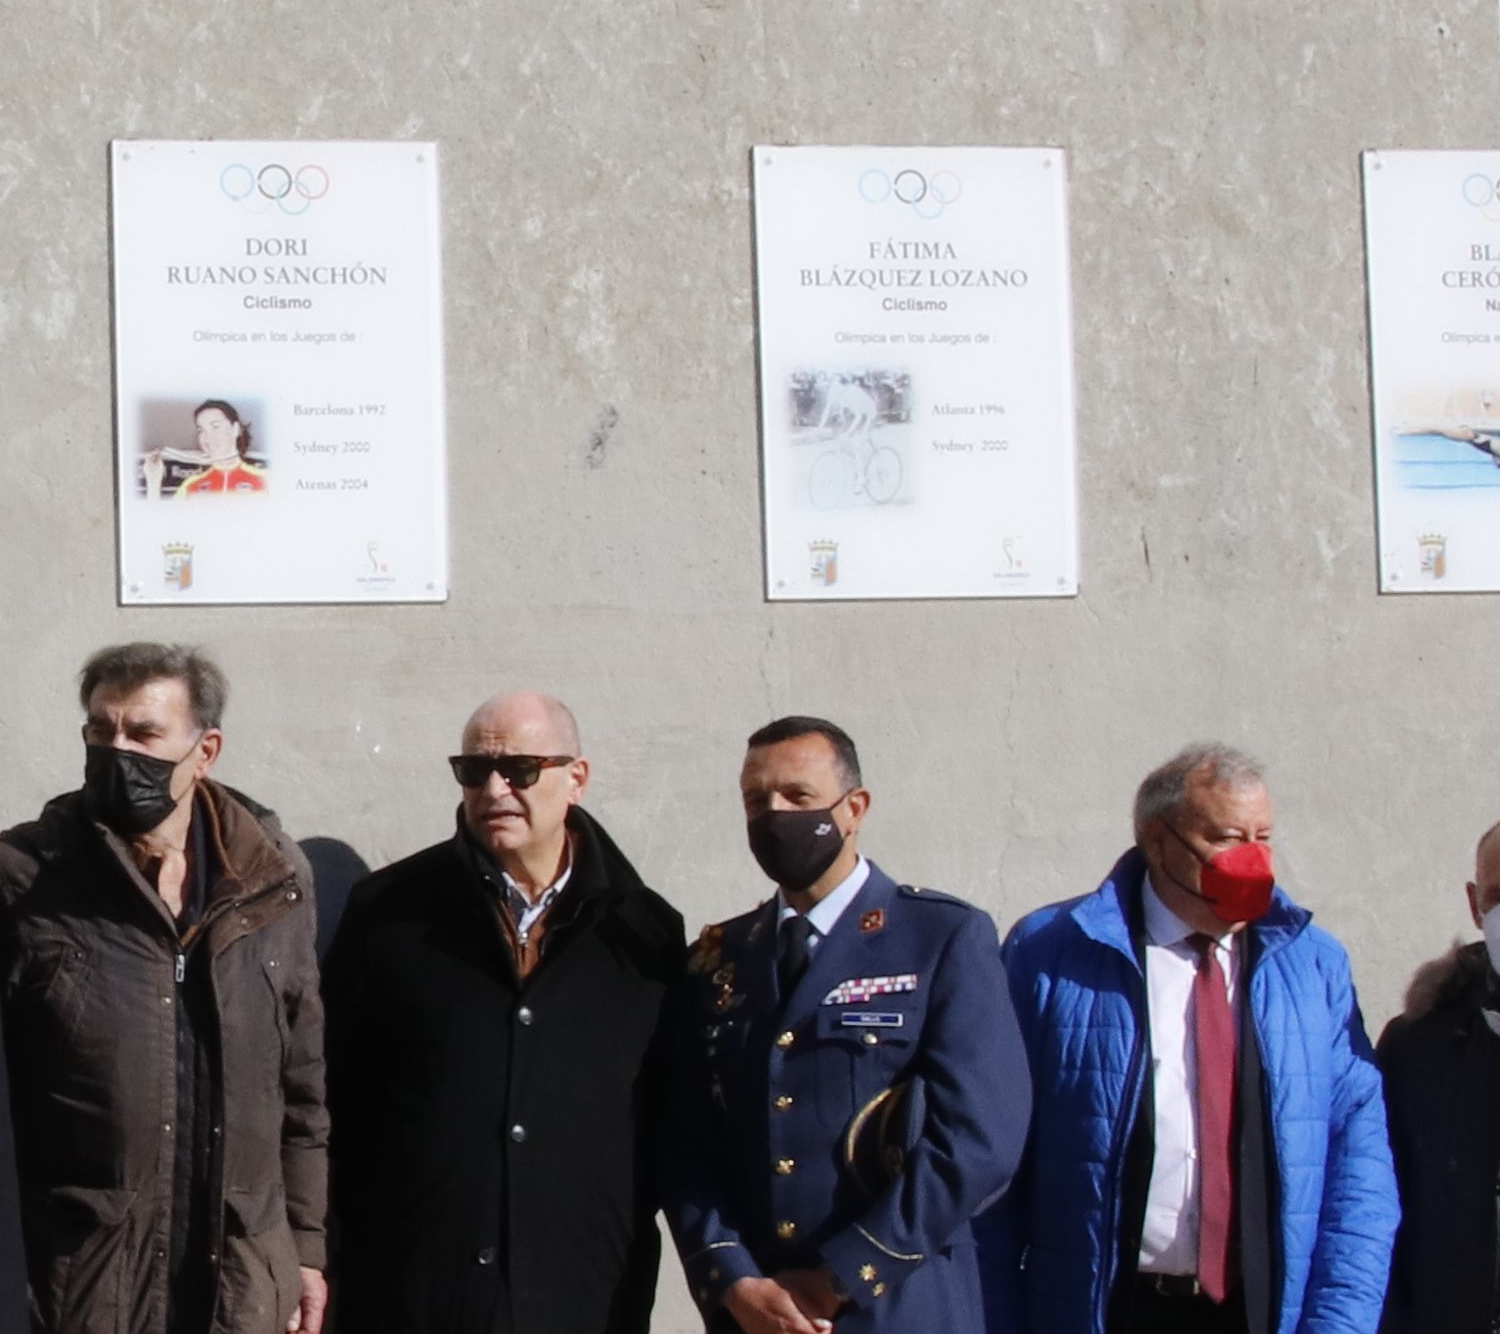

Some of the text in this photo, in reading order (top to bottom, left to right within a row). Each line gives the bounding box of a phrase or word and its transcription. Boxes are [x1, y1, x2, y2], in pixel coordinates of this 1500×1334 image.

[246, 238, 307, 256] DORI
[870, 238, 956, 259] FÁTIMA
[168, 262, 386, 284] RUANO SANCHÓN
[801, 265, 1028, 290] BLÁZQUEZ LOZANO
[243, 295, 312, 309] Ciclismo
[882, 297, 948, 311] Ciclismo
[251, 333, 267, 342] en
[270, 331, 288, 342] los
[291, 331, 336, 345] Juegos
[340, 331, 356, 342] de
